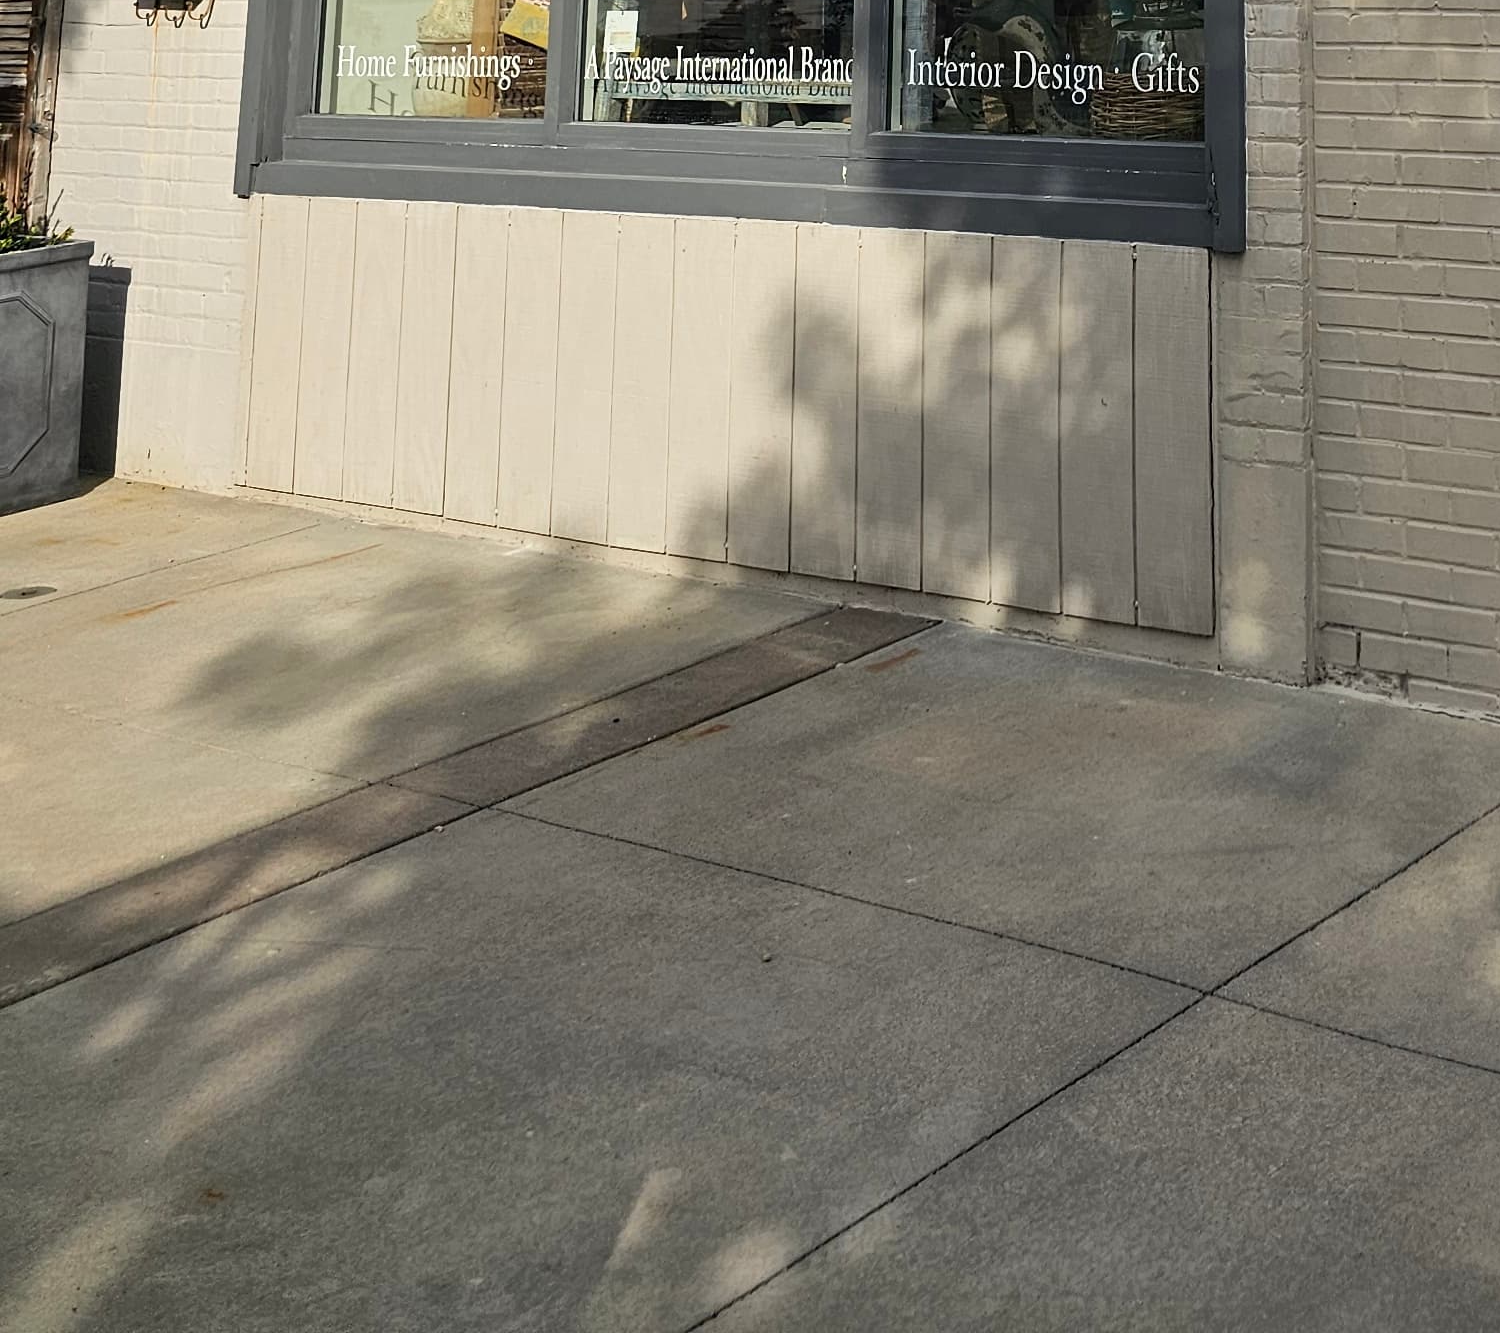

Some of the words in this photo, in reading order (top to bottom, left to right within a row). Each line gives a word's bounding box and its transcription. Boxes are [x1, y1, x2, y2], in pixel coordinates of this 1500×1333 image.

[336, 44, 397, 78] Home
[402, 44, 521, 91] Furnishings
[583, 44, 600, 81] A
[603, 45, 671, 94] Paysage
[674, 44, 795, 83] International
[907, 47, 1006, 89] Interior
[1012, 50, 1105, 105] Design
[1130, 51, 1200, 95] Gifts
